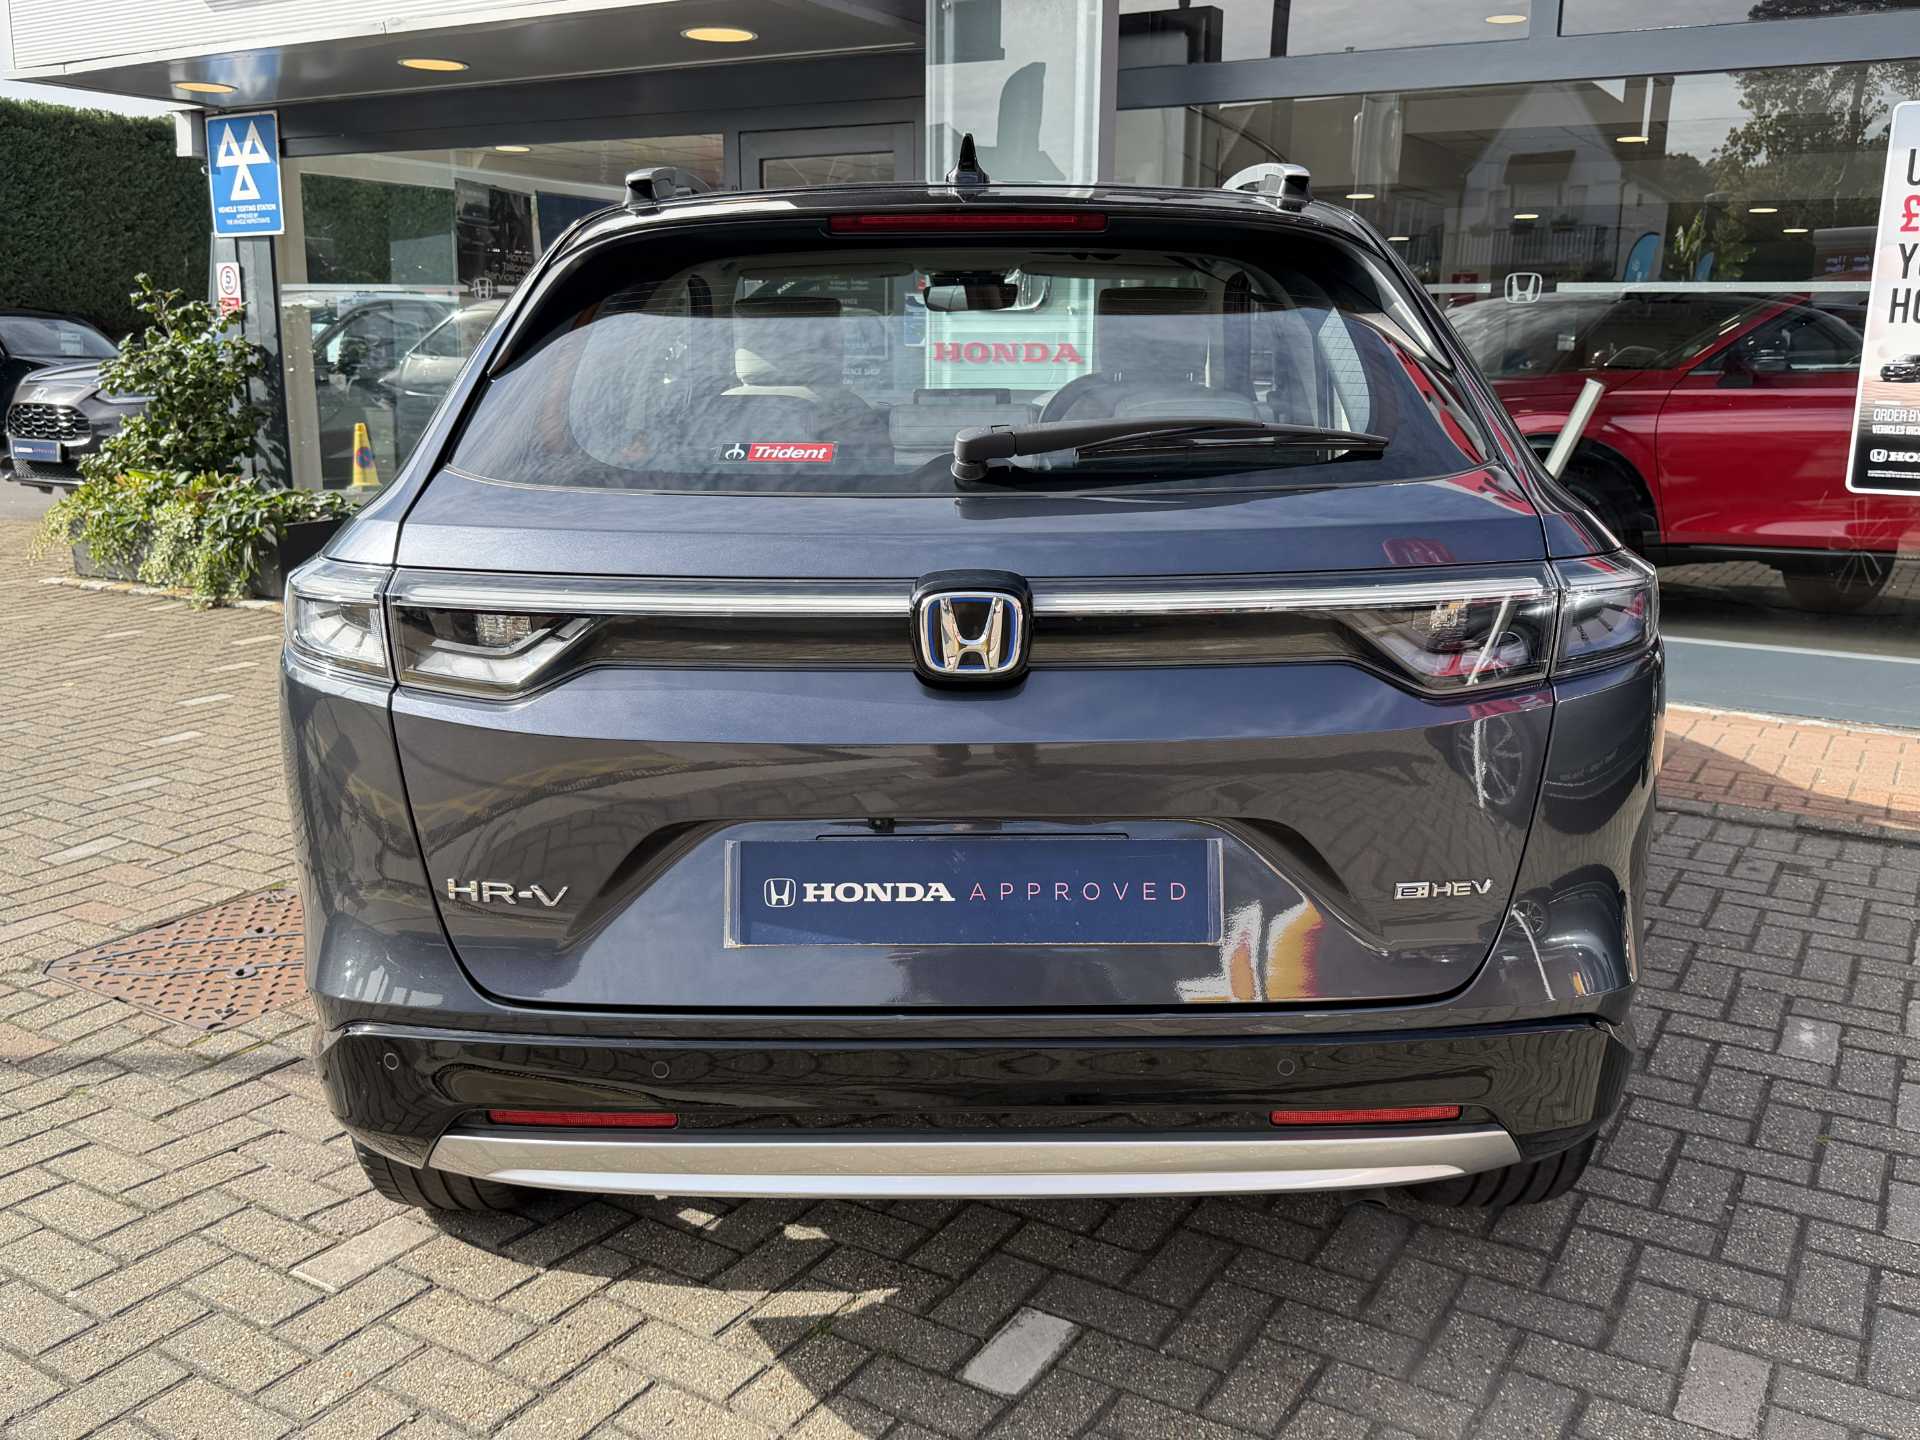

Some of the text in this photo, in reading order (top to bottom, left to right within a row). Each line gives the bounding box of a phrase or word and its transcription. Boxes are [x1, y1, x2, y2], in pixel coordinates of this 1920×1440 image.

[933, 341, 1085, 364] HONDA
[1873, 408, 1907, 421] ORDER
[754, 446, 828, 459] Trident
[1888, 452, 1920, 463] HO
[447, 879, 568, 907] HR-V
[802, 882, 1186, 902] HONDA APPROVED
